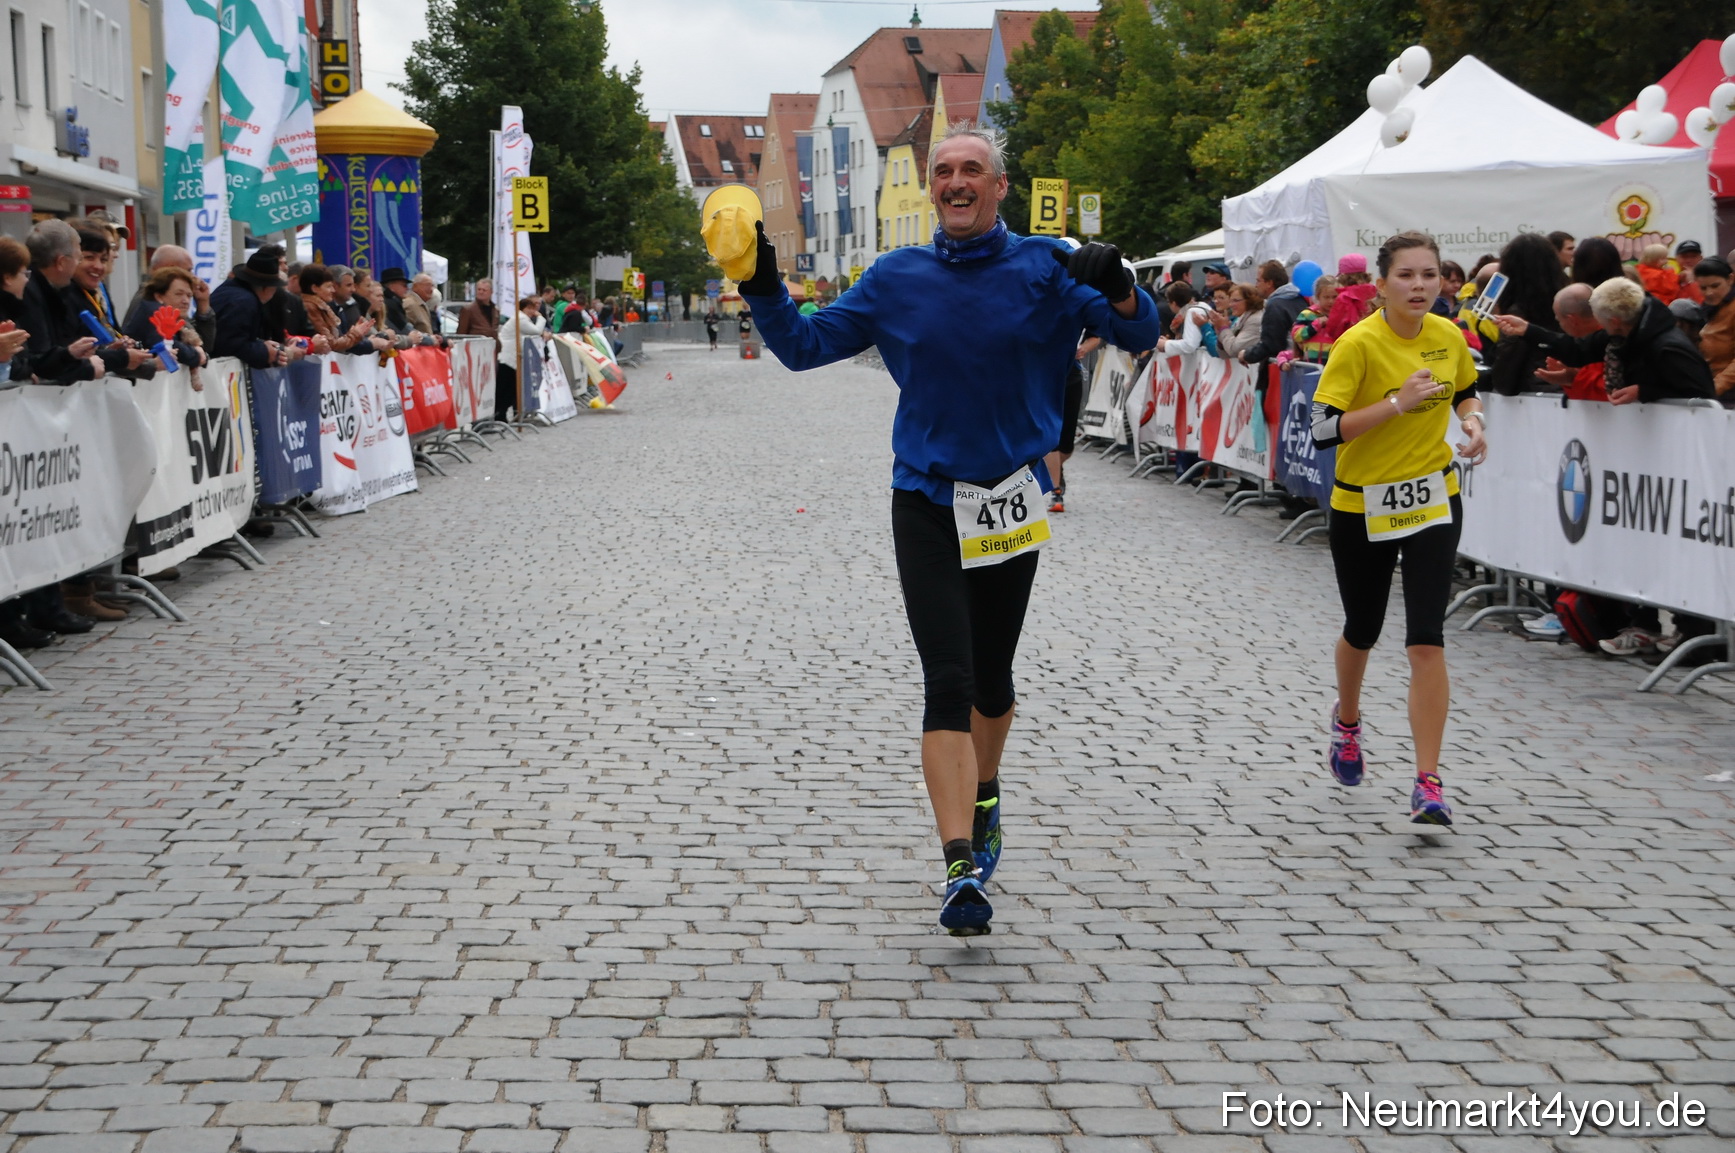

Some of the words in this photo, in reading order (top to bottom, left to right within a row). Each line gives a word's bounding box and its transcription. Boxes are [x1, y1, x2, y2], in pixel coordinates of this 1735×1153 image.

[323, 42, 350, 108] HO
[516, 179, 544, 190] Block
[1036, 180, 1064, 192] Block
[521, 193, 540, 220] B
[1040, 195, 1058, 222] B
[1382, 478, 1431, 510] 435
[1601, 469, 1674, 536] BMW
[976, 492, 1028, 530] 478
[1389, 513, 1427, 528] Denise
[980, 529, 1033, 553] Siegfried
